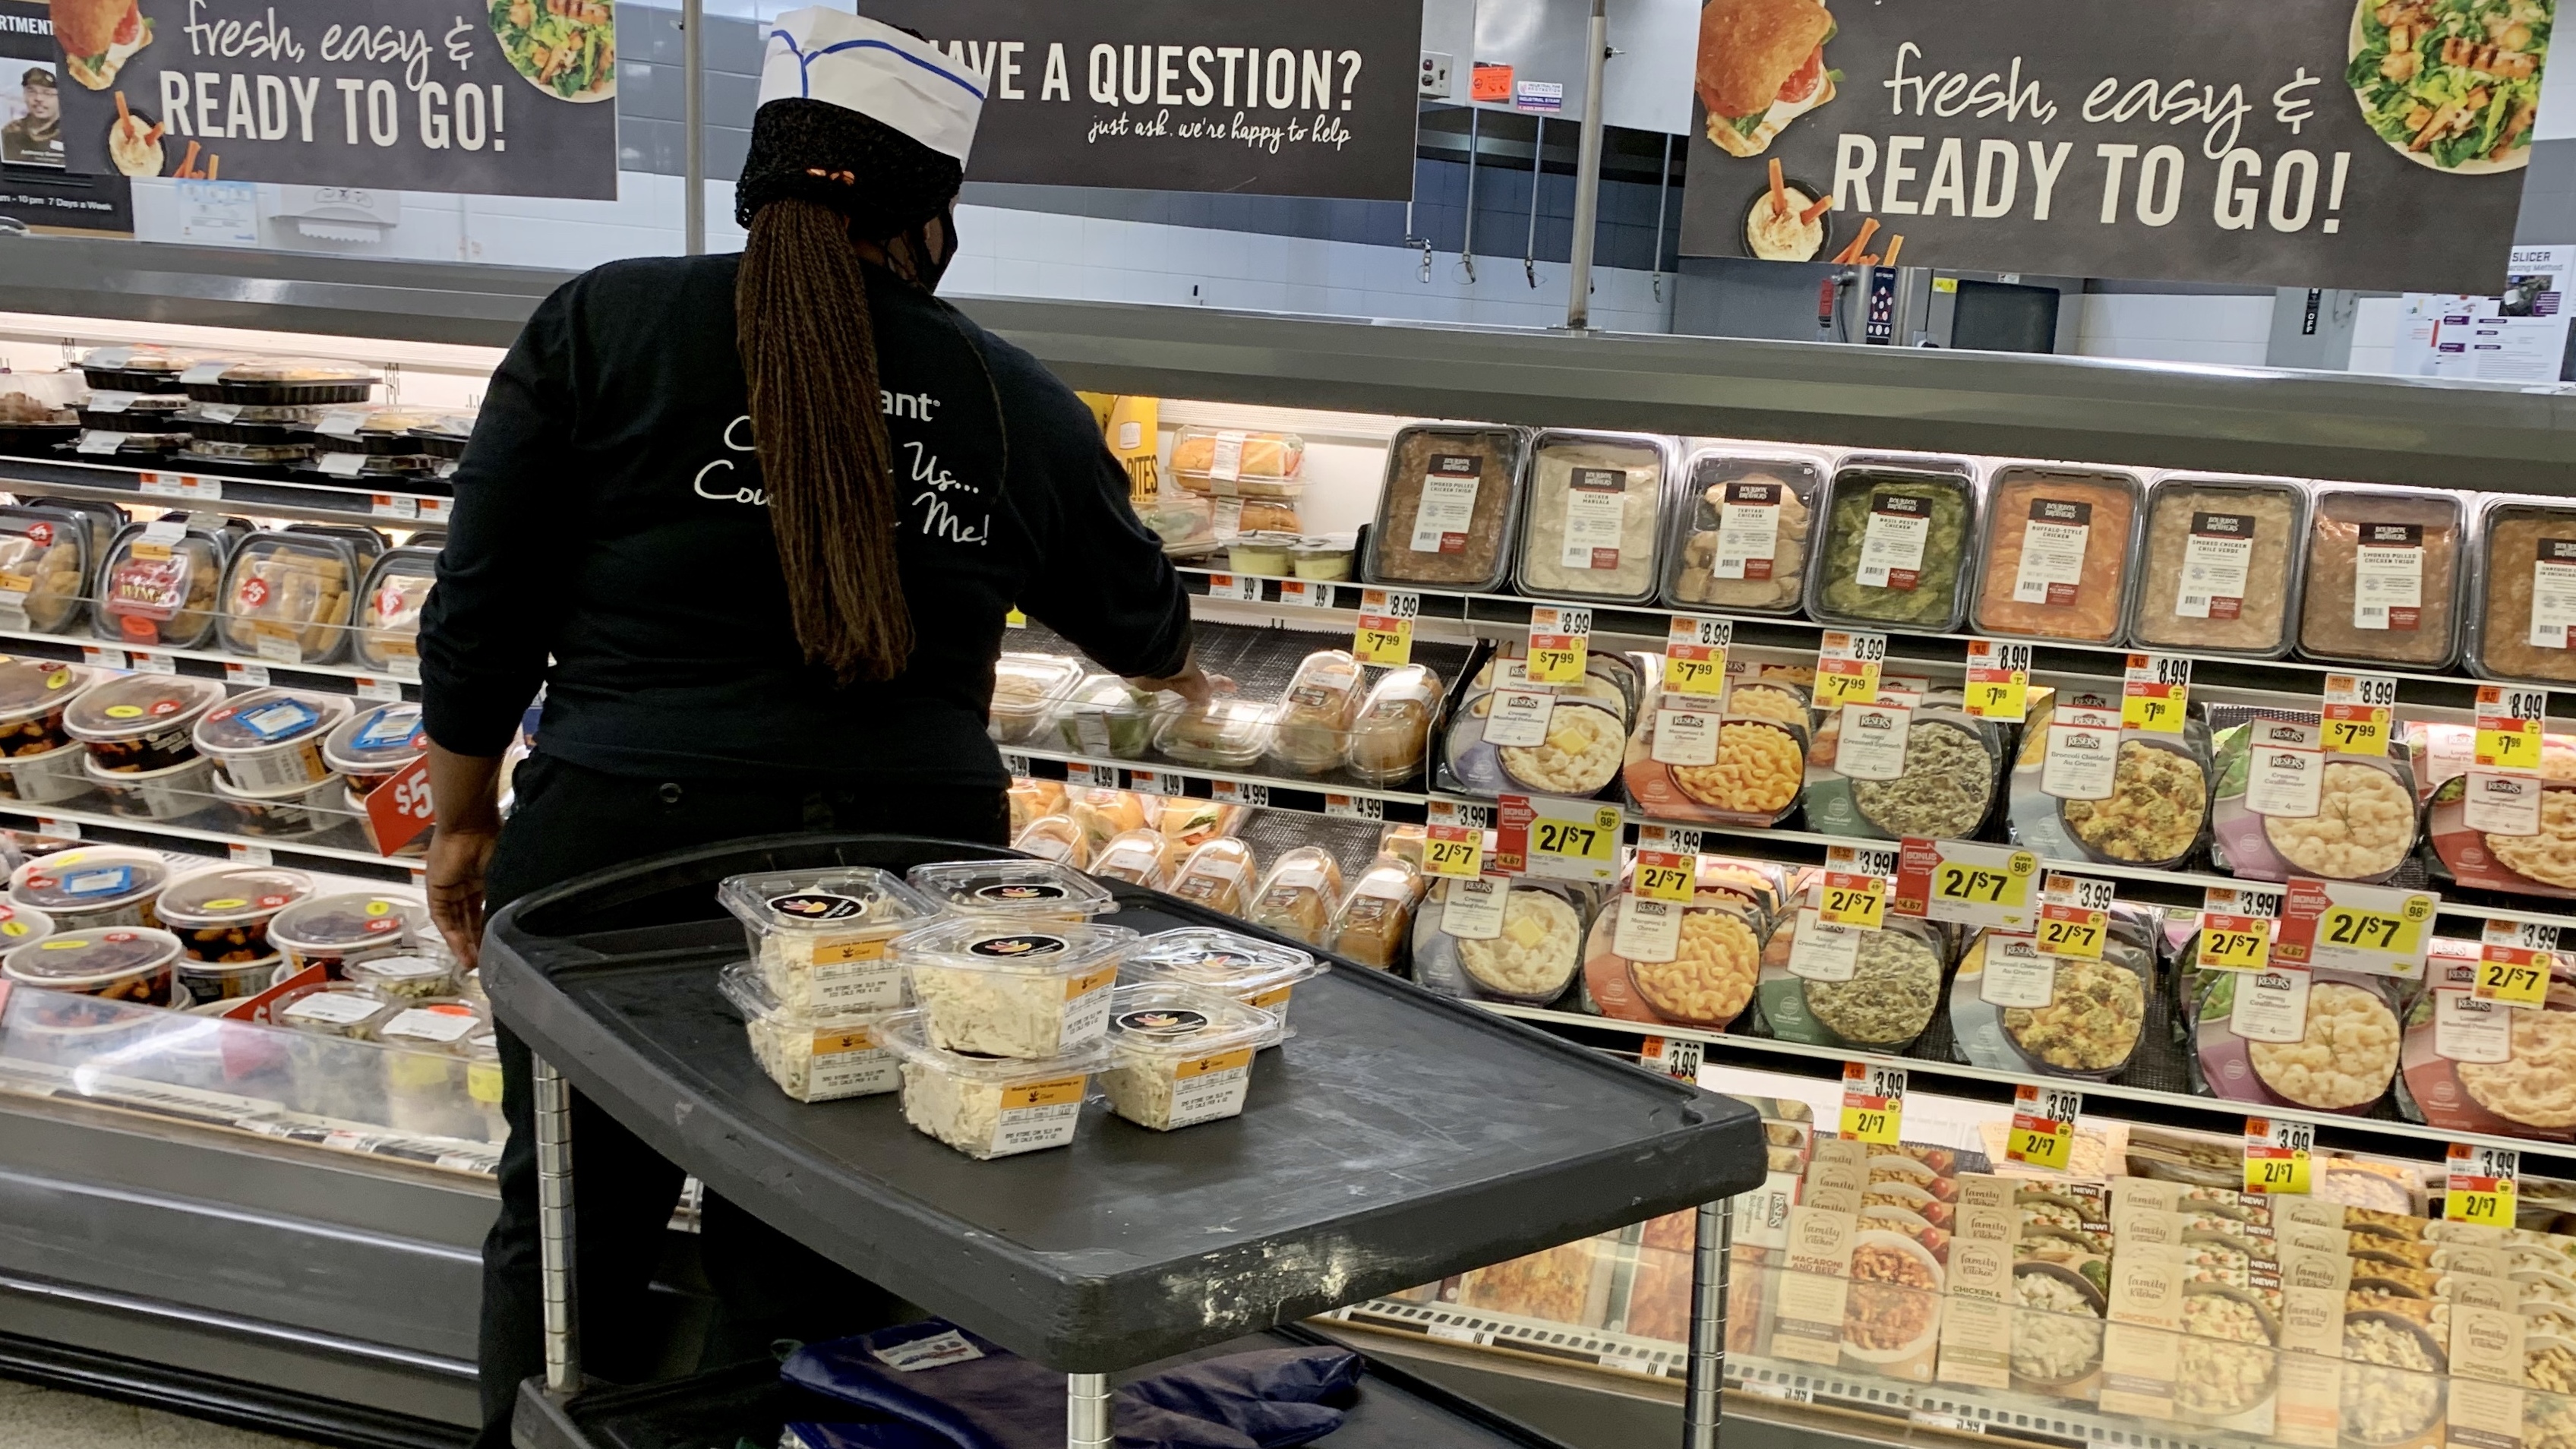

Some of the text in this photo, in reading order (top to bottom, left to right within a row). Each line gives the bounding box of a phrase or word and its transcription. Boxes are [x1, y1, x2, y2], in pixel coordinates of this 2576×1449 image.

[184, 0, 474, 91] fresh, easy &
[1041, 43, 1071, 101] A
[1088, 43, 1362, 111] QUESTION?
[160, 70, 505, 152] READY TO GO!
[1883, 42, 2322, 160] fresh, easy &
[1088, 111, 1130, 144] just
[1179, 116, 1226, 140] we're
[1231, 111, 1286, 153] happy
[1288, 115, 1309, 142] to
[1312, 115, 1352, 150] help
[1831, 133, 2351, 233] READY TO GO!
[49, 197, 54, 206] 7
[56, 198, 79, 209] Days
[87, 200, 112, 211] Week
[2512, 251, 2551, 263] SLICER
[879, 390, 933, 421] ant
[912, 491, 990, 547] Me!
[1390, 595, 1416, 617] $8.99
[1562, 612, 1590, 634] $8.99
[1701, 623, 1730, 646] $8.99
[1854, 637, 1884, 661] $8.99
[1998, 646, 2028, 671] $8.99
[2158, 659, 2189, 686] $8.99
[2360, 680, 2392, 705] $8.99
[2508, 693, 2543, 720] $8.99
[2081, 753, 2111, 762] Cheddar
[394, 769, 432, 819] $5
[1457, 805, 1485, 828] $3.99
[1504, 807, 1531, 817] BONUS
[1540, 825, 1596, 856] 2/$7
[1670, 829, 1699, 854] $3.99
[1433, 843, 1473, 865] 2/$7
[1859, 851, 1890, 876] $3.99
[1905, 851, 1937, 863] BONUS
[1644, 869, 1687, 891] 2/$7
[1944, 869, 2008, 902] 2/$7
[1830, 891, 1877, 914] 2/$7
[2079, 882, 2112, 911] $3.99
[2241, 892, 2275, 917] $3.99
[2293, 894, 2326, 907] BONUS
[2048, 923, 2097, 947] 2/$7
[2330, 914, 2401, 949] 2/$7
[2522, 922, 2557, 949] $3.99
[2211, 933, 2260, 958] 2/$7
[1990, 959, 2049, 971] Broccoli Cheddar
[2488, 965, 2540, 991] 2/$7
[1874, 1071, 1904, 1098] $3.99
[2046, 1094, 2077, 1123] $3.99
[1858, 1113, 1886, 1134] 2/$7
[2026, 1135, 2055, 1156] 2/$7
[2265, 1163, 2293, 1183] 2/$7
[2481, 1151, 2514, 1179] $3.99
[1965, 1187, 2000, 1201] family
[2072, 1186, 2097, 1195] NEW!
[2240, 1196, 2265, 1206] NEW!
[2467, 1195, 2496, 1217] 2/$7
[1804, 1223, 1841, 1242] family
[1971, 1218, 2007, 1235] family
[1974, 1230, 2002, 1241] Kitchen
[2083, 1222, 2107, 1231] NEW!
[2246, 1226, 2272, 1236] NEW!
[1805, 1235, 1835, 1247] Kitchen
[1792, 1255, 1843, 1270] MACARONI
[1792, 1262, 1839, 1275] AND BEEF
[1961, 1255, 1998, 1272] family
[1963, 1266, 1994, 1277] Kitchen
[2251, 1261, 2277, 1271] NEW!
[2128, 1274, 2167, 1292] family
[2251, 1277, 2278, 1287] NEW!
[2297, 1266, 2334, 1285] family
[1953, 1286, 1994, 1297] CHICKEN
[2287, 1304, 2327, 1323] family
[2469, 1323, 2508, 1344] family
